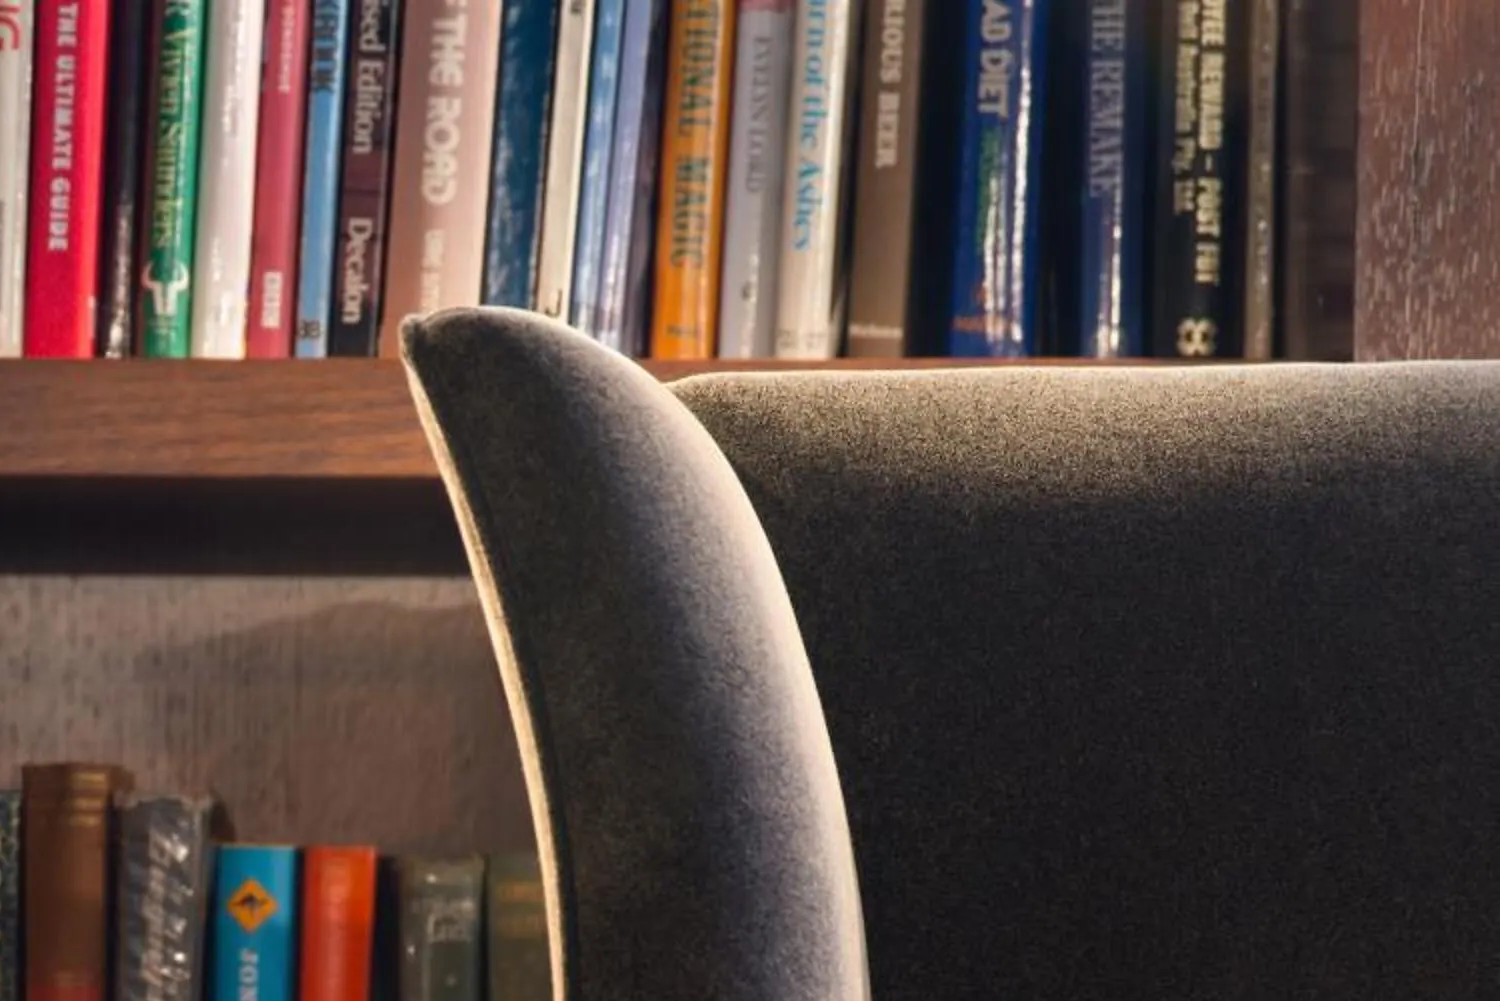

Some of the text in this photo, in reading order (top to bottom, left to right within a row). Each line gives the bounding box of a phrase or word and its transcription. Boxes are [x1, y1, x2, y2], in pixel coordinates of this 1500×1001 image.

[430, 17, 468, 86] THE
[977, 49, 1011, 118] DIET
[47, 2, 78, 252] THE ULTIMATE GUIDE
[352, 58, 384, 155] Edition
[801, 95, 828, 148] the
[875, 90, 902, 169] BEER
[1088, 58, 1125, 198] REMAKE
[420, 97, 462, 206] ROAD
[793, 157, 823, 252] Ashes
[1195, 176, 1223, 238] POST
